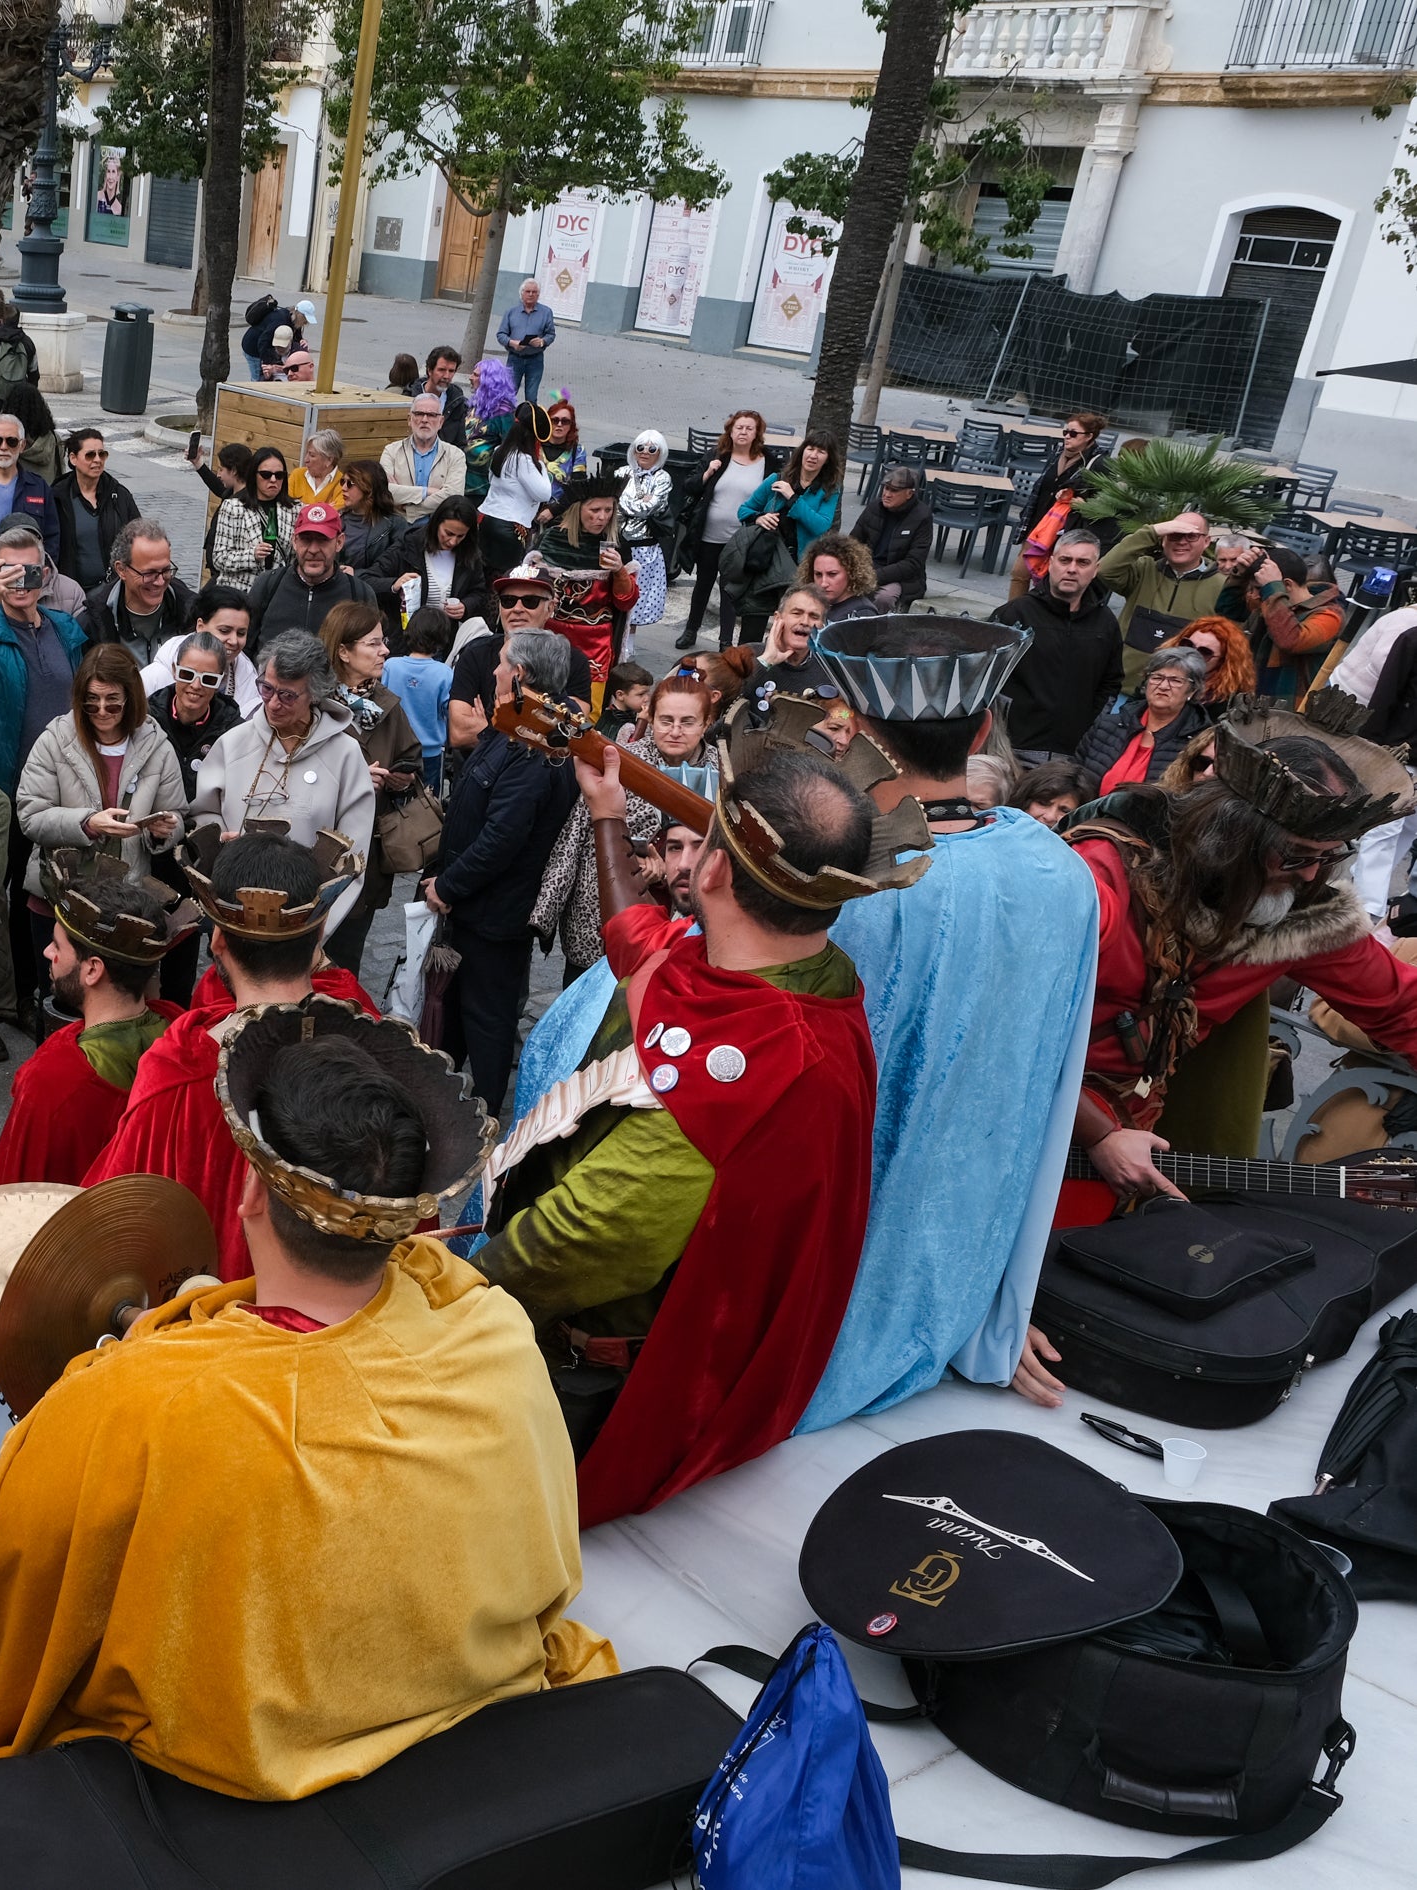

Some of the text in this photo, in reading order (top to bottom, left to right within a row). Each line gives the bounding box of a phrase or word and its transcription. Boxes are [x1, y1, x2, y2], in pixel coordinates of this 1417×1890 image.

[557, 214, 590, 231] DYC
[784, 235, 824, 254] DYC
[668, 265, 686, 275] DYC
[925, 1517, 1013, 1560] Triana
